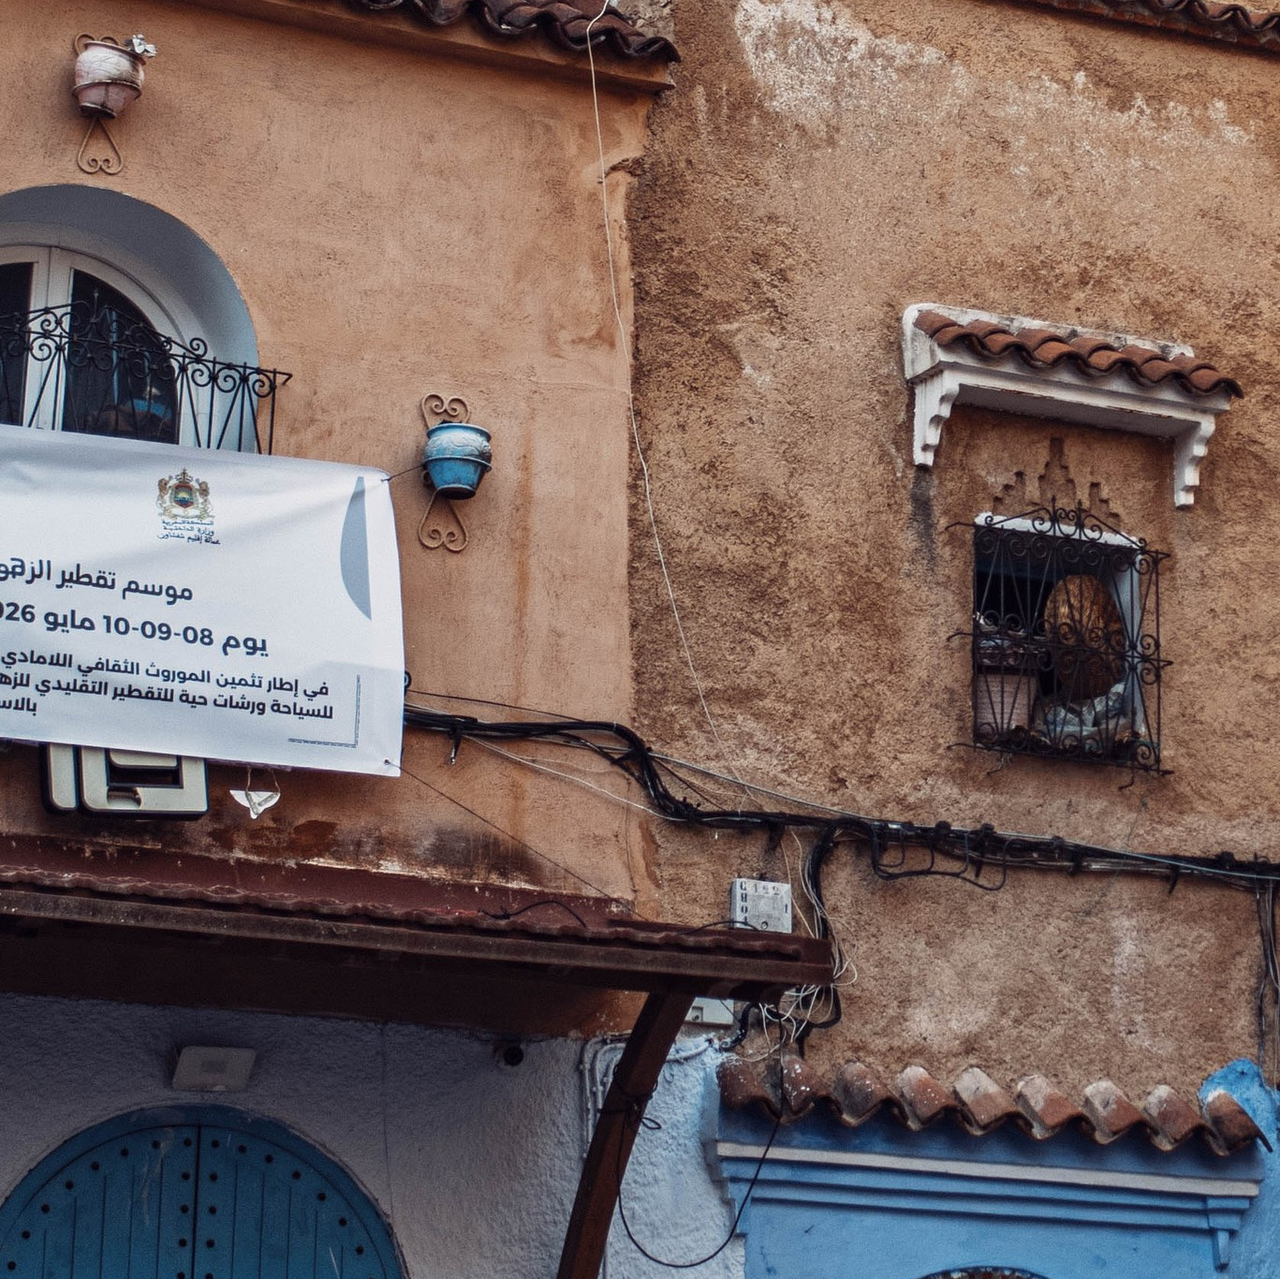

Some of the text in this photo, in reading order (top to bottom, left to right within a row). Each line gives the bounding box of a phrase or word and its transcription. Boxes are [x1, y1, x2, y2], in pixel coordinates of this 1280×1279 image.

[55, 563, 116, 589] تقطير
[122, 579, 193, 606] موسم
[44, 609, 96, 633] مايو
[103, 615, 214, 646] 10-09-08
[222, 633, 269, 658] يوم
[1, 650, 329, 702] في إطار تثمين الموروث الثقافي اللامادي
[35, 679, 108, 697] التقليدي
[112, 684, 174, 702] للتقطير
[179, 689, 208, 708] حية
[213, 694, 266, 715] ورشات
[270, 698, 333, 721] للسياحة
